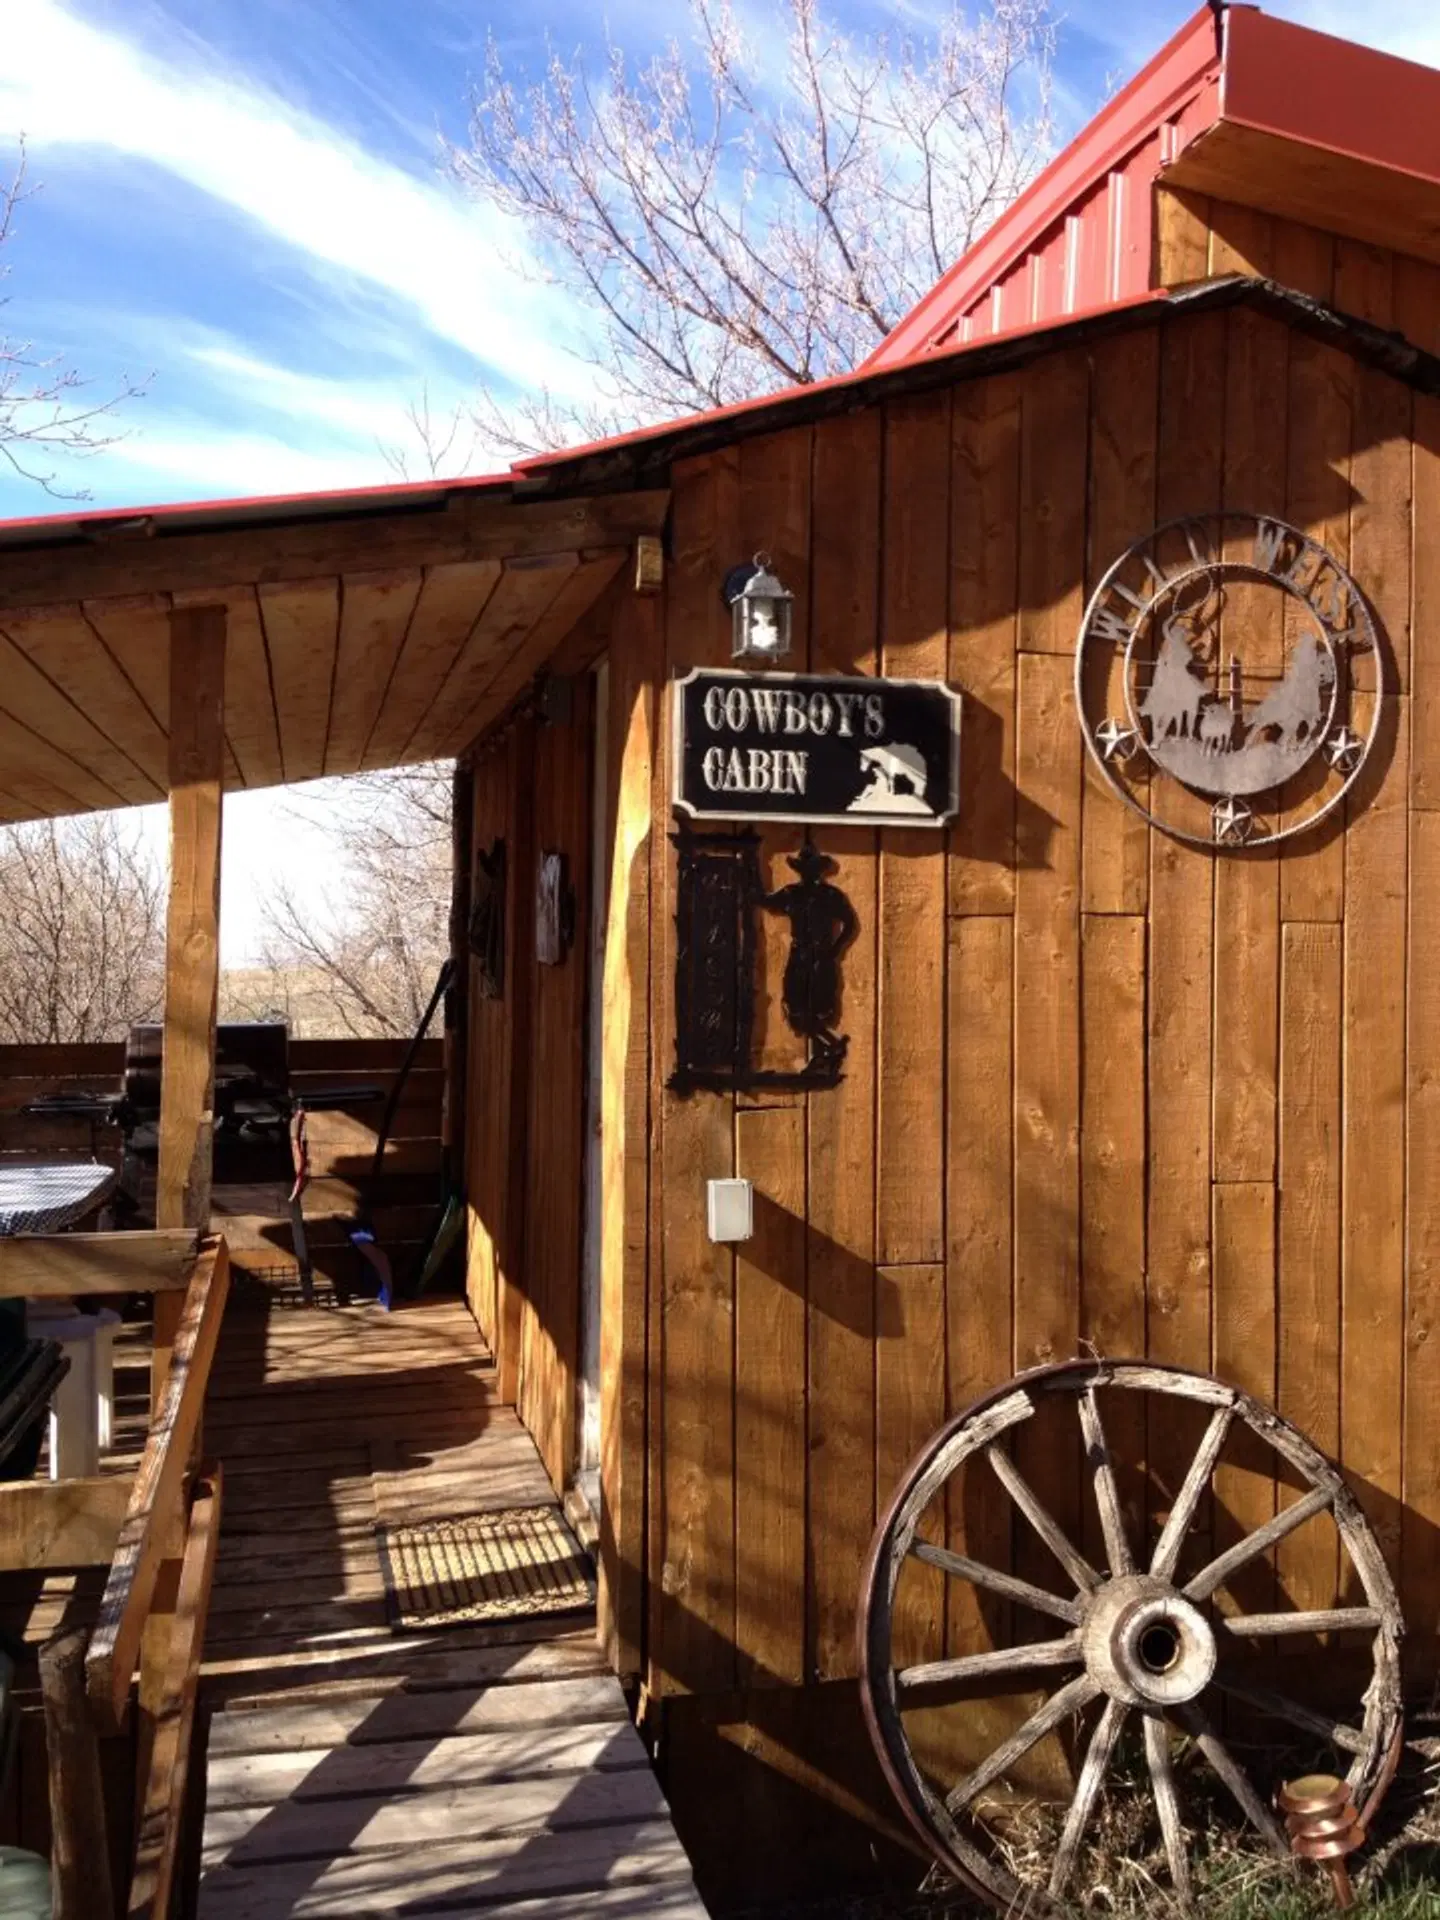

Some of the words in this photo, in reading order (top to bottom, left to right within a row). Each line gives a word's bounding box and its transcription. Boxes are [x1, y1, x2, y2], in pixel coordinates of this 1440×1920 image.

[1253, 518, 1373, 644] WEST
[703, 686, 884, 738] COWBOY'S
[702, 746, 808, 795] CABIN
